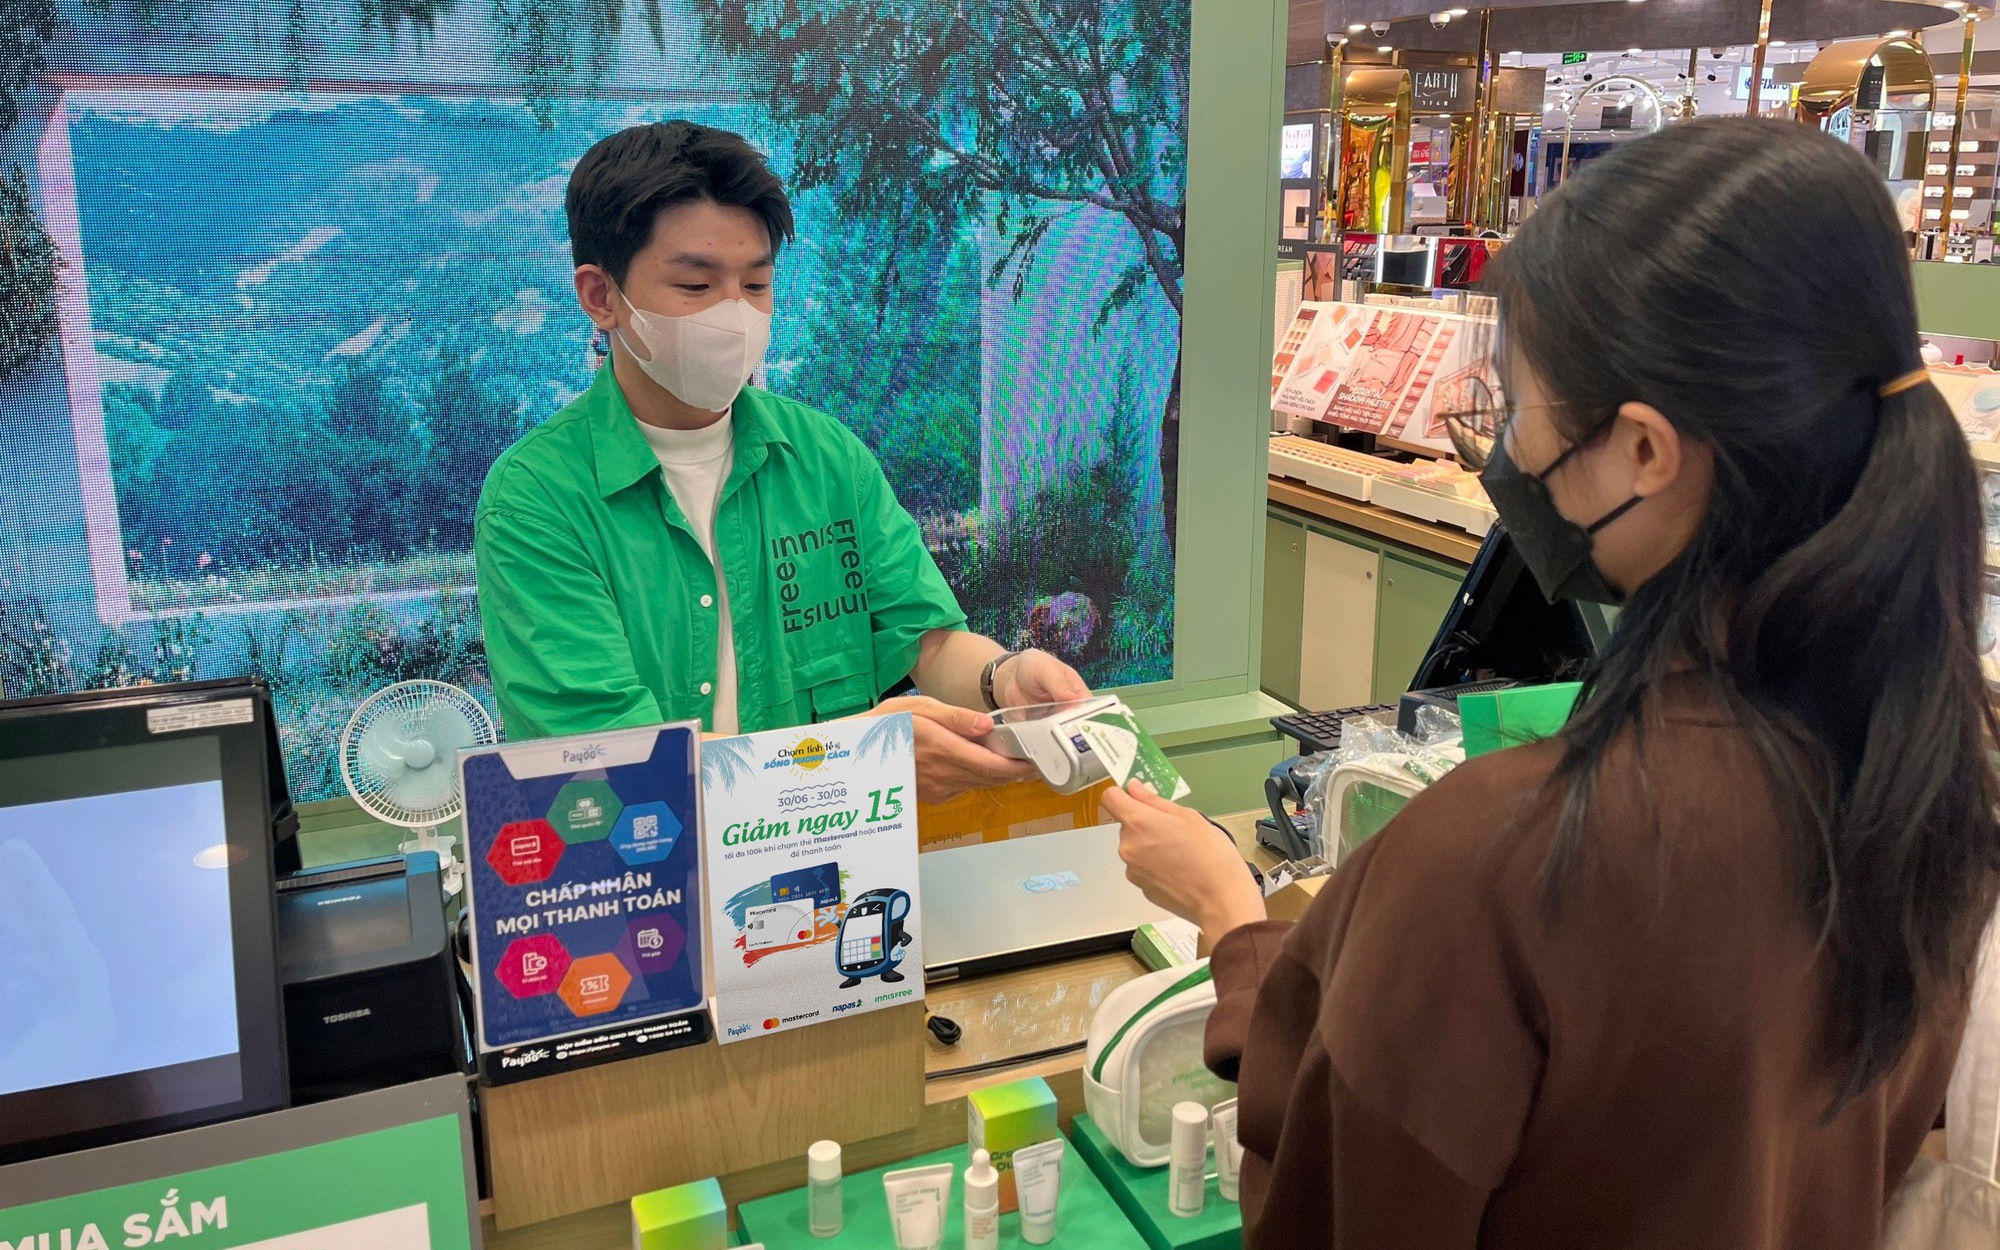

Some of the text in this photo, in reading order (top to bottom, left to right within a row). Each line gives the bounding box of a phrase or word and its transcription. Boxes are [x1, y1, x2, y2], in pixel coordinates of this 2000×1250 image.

[1415, 72, 1458, 98] EARTH
[563, 749, 597, 763] Payoo
[764, 749, 850, 770] SỐNG PHONG CÁCH
[777, 747, 804, 759] Chạm
[777, 793, 809, 807] 30/06
[817, 787, 848, 802] 30/08
[722, 818, 791, 847] Giảm
[797, 809, 859, 836] ngay
[747, 846, 763, 856] 100k
[764, 843, 776, 853] khi
[777, 841, 799, 852] chạm
[813, 829, 858, 844] Mastercard
[858, 826, 877, 838] hoặc
[801, 845, 824, 857] thanh
[824, 842, 842, 854] toán
[525, 871, 652, 907] CHẤP NHẬN
[496, 889, 682, 935] MỌI THANH TOÁN
[323, 1007, 371, 1025] TOSHIBA
[832, 1001, 856, 1013] napas
[782, 1010, 820, 1024] mastercard
[728, 1025, 747, 1036] Payoo
[502, 1052, 540, 1069] Payoo
[123, 1188, 228, 1248] SẮM
